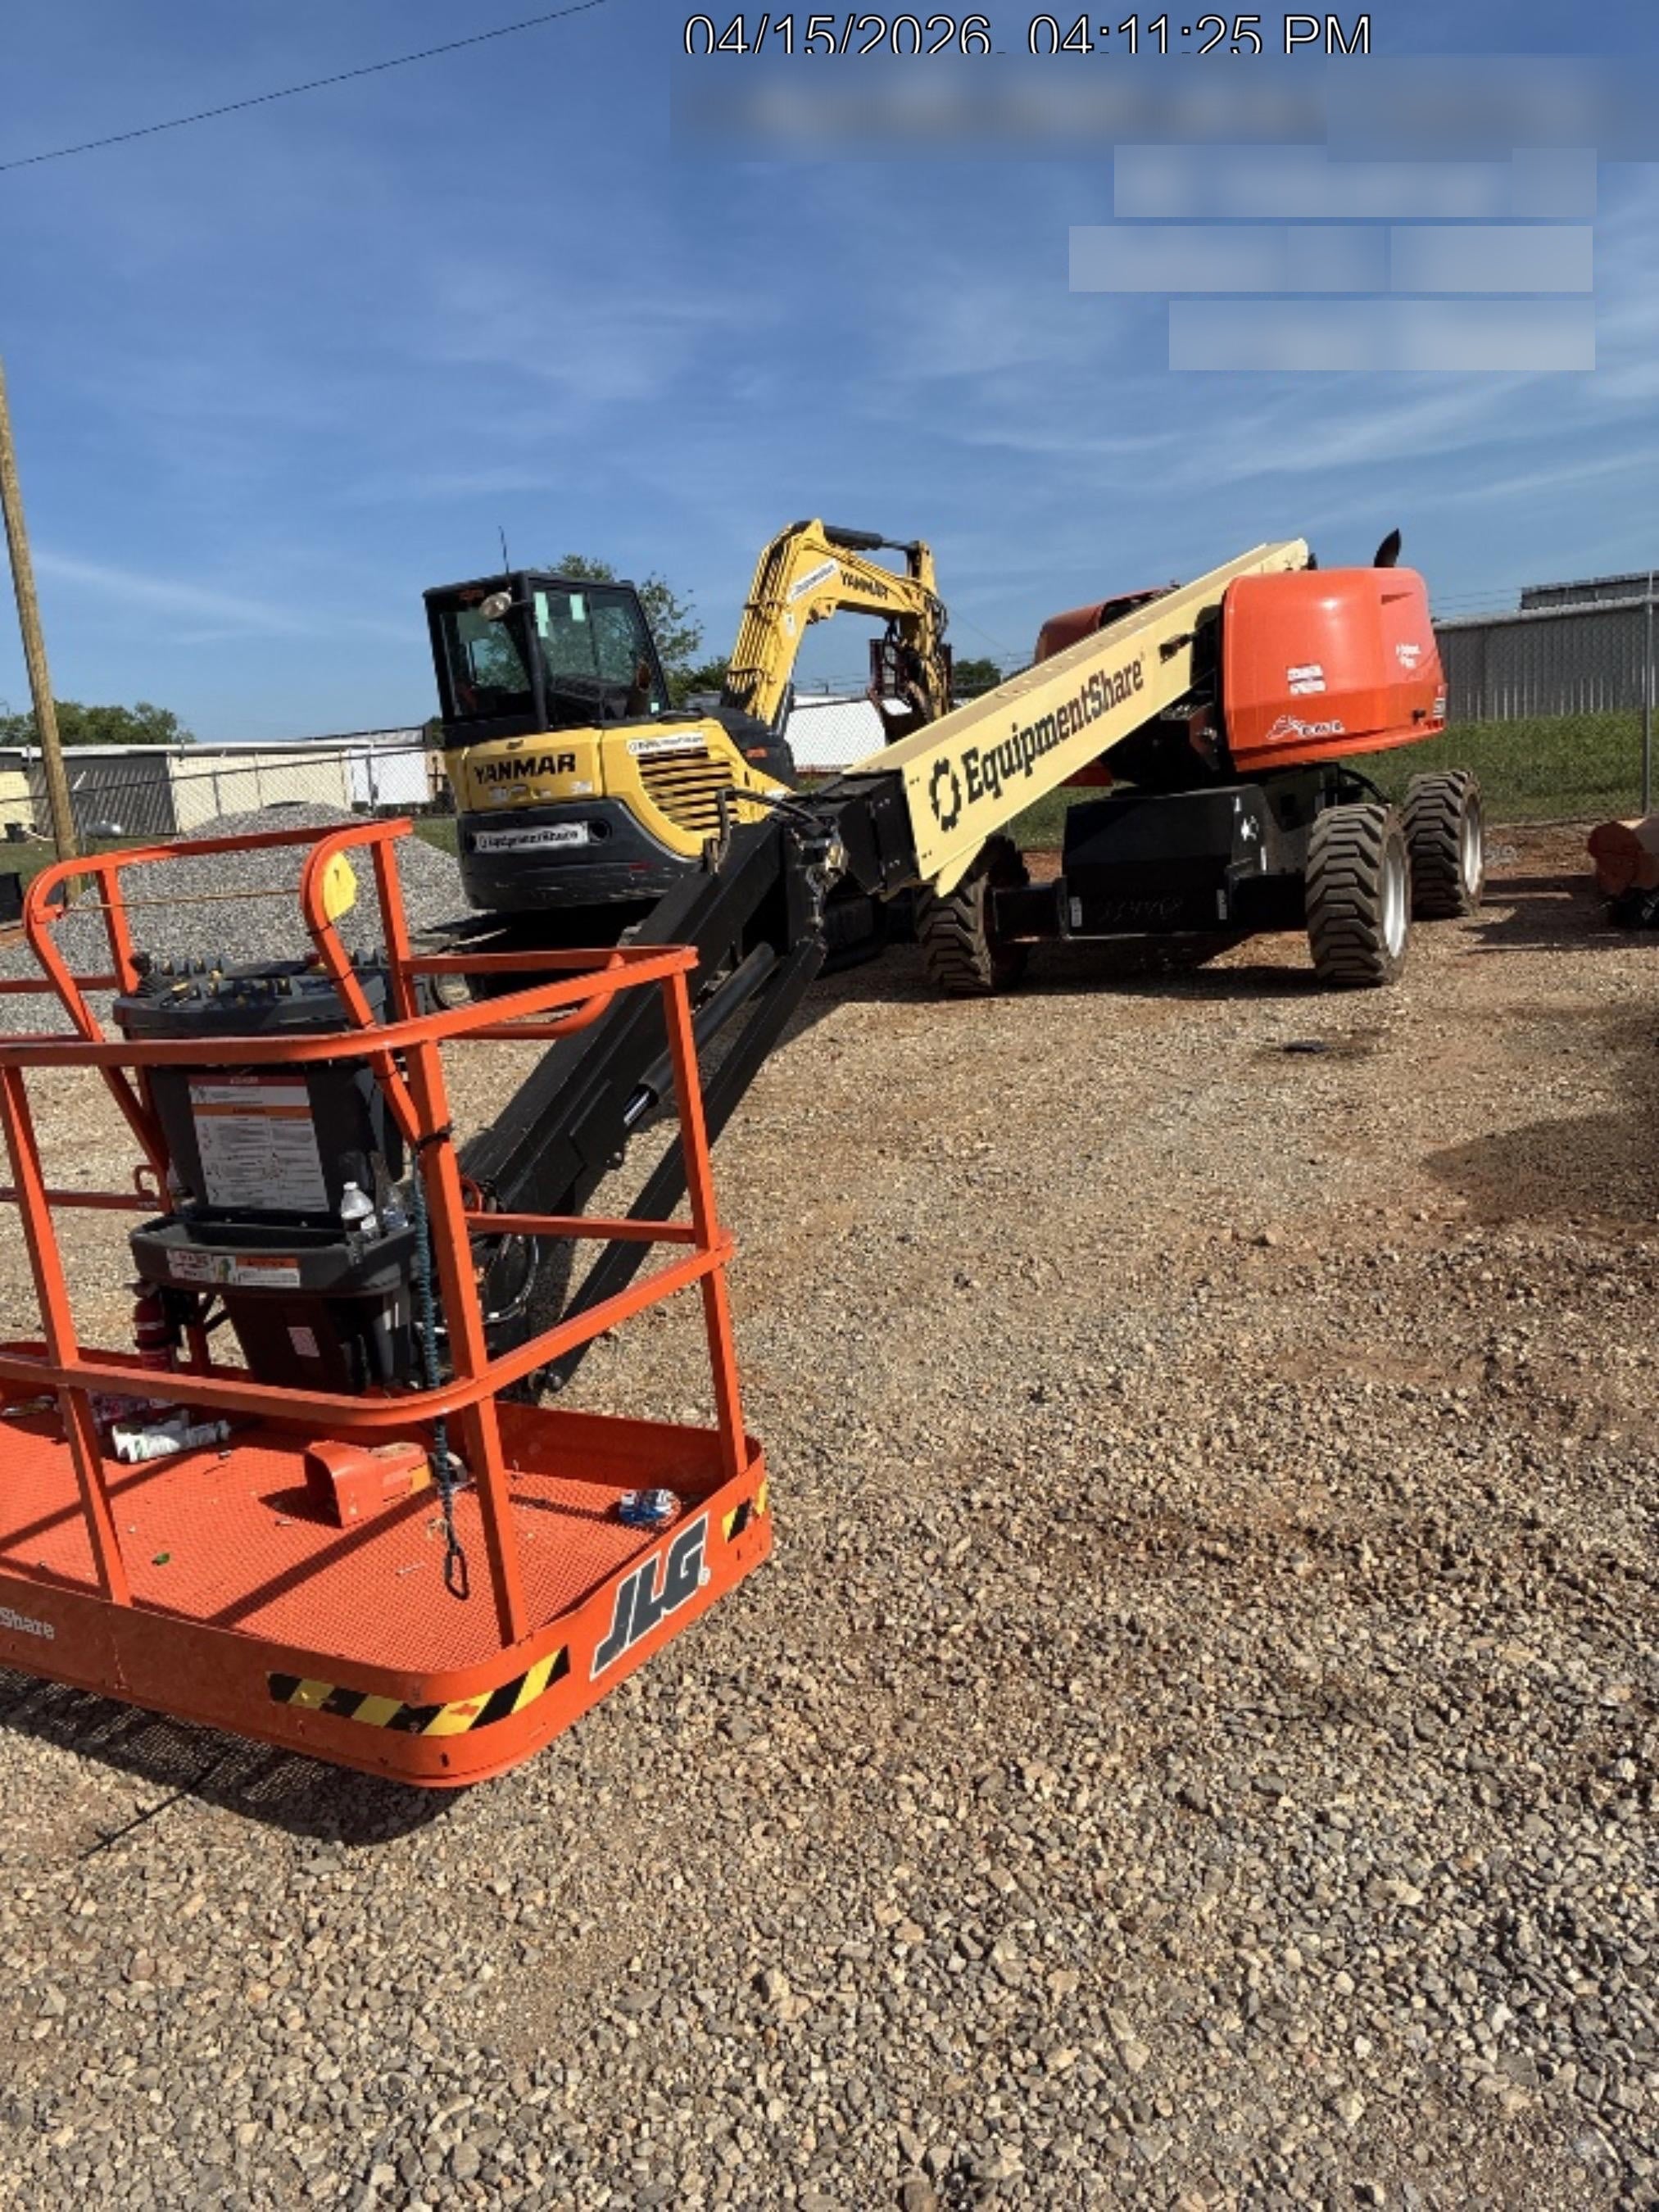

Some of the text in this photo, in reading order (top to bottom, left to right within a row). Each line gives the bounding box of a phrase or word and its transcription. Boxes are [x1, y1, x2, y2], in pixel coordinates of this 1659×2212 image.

[474, 753, 576, 784] YANMAR
[961, 660, 1144, 805] EquipmentShare
[589, 1511, 709, 1682] JLG
